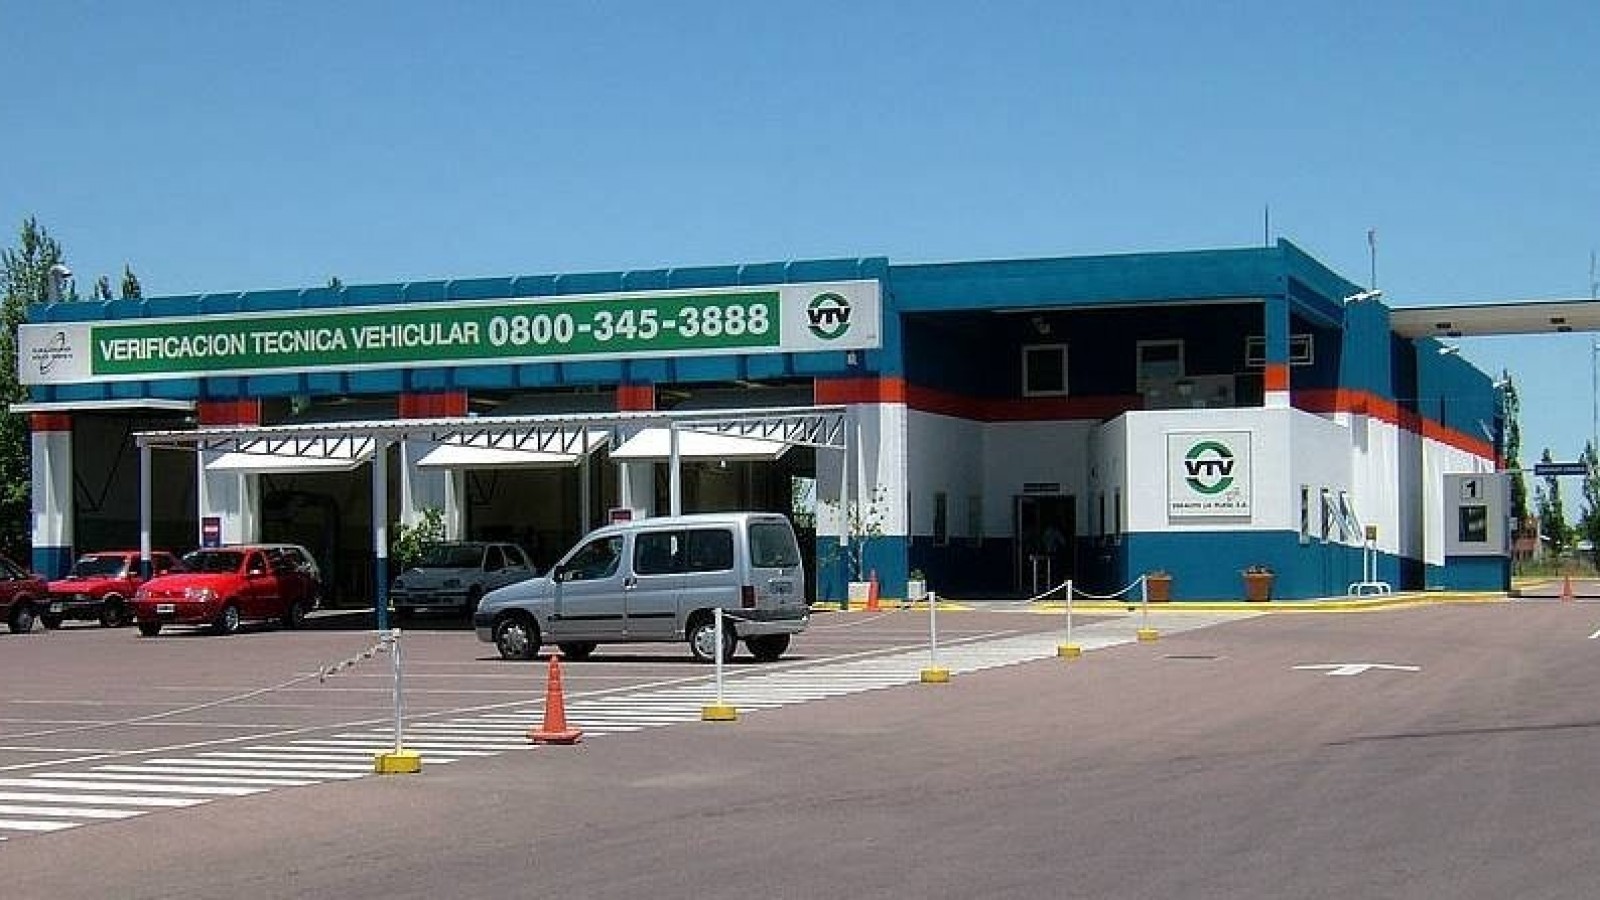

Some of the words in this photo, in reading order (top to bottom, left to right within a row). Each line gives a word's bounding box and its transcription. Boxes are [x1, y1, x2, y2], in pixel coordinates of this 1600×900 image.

[807, 308, 850, 324] VTV
[100, 333, 246, 361] VERIFICACION
[252, 327, 347, 354] TECNICA
[351, 322, 480, 349] VEHICULAR
[488, 303, 769, 347] 0800-345-3888
[1184, 460, 1233, 475] VTV
[1466, 480, 1475, 497] 1
